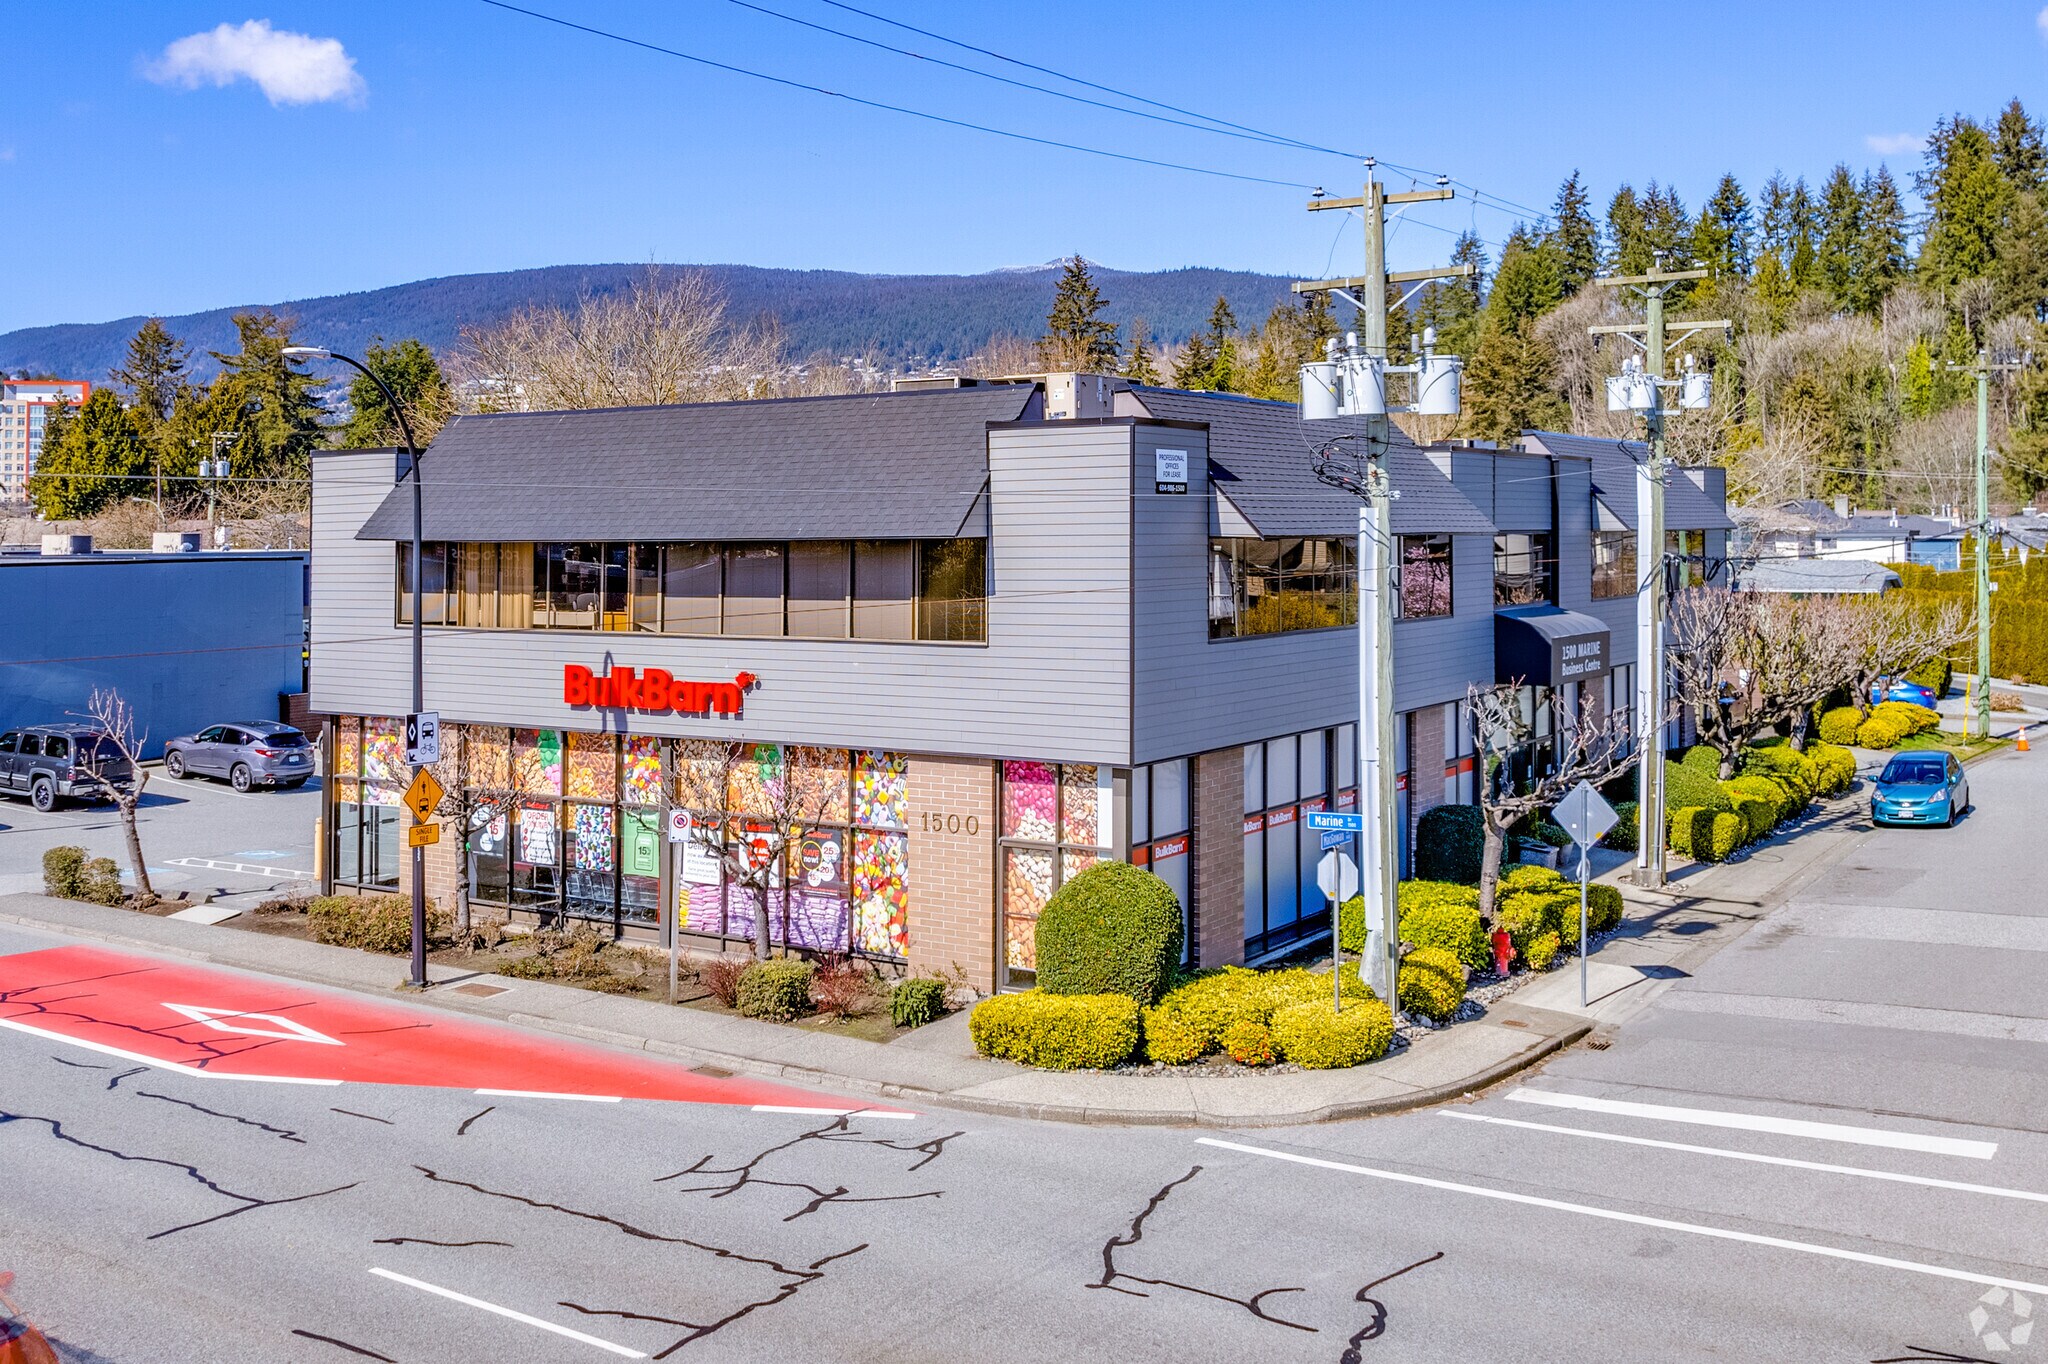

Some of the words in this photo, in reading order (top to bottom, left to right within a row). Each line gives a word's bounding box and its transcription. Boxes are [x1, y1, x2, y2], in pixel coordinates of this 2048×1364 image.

[1159, 454, 1184, 462] PROFESSIONAL
[1562, 645, 1577, 660] 1500
[1578, 641, 1600, 656] MARINE
[1562, 661, 1584, 677] Business
[1584, 659, 1601, 672] Centre
[564, 664, 744, 714] BulkBarn
[526, 811, 549, 821] ORDER
[1269, 810, 1294, 826] BulkBarn
[1315, 815, 1344, 827] Marine
[921, 811, 979, 836] 1500
[416, 826, 433, 836] SINGLE
[419, 835, 429, 843] FILE
[802, 848, 820, 857] SAVE
[1155, 840, 1185, 859] BulkBarn
[803, 856, 819, 864] now!
